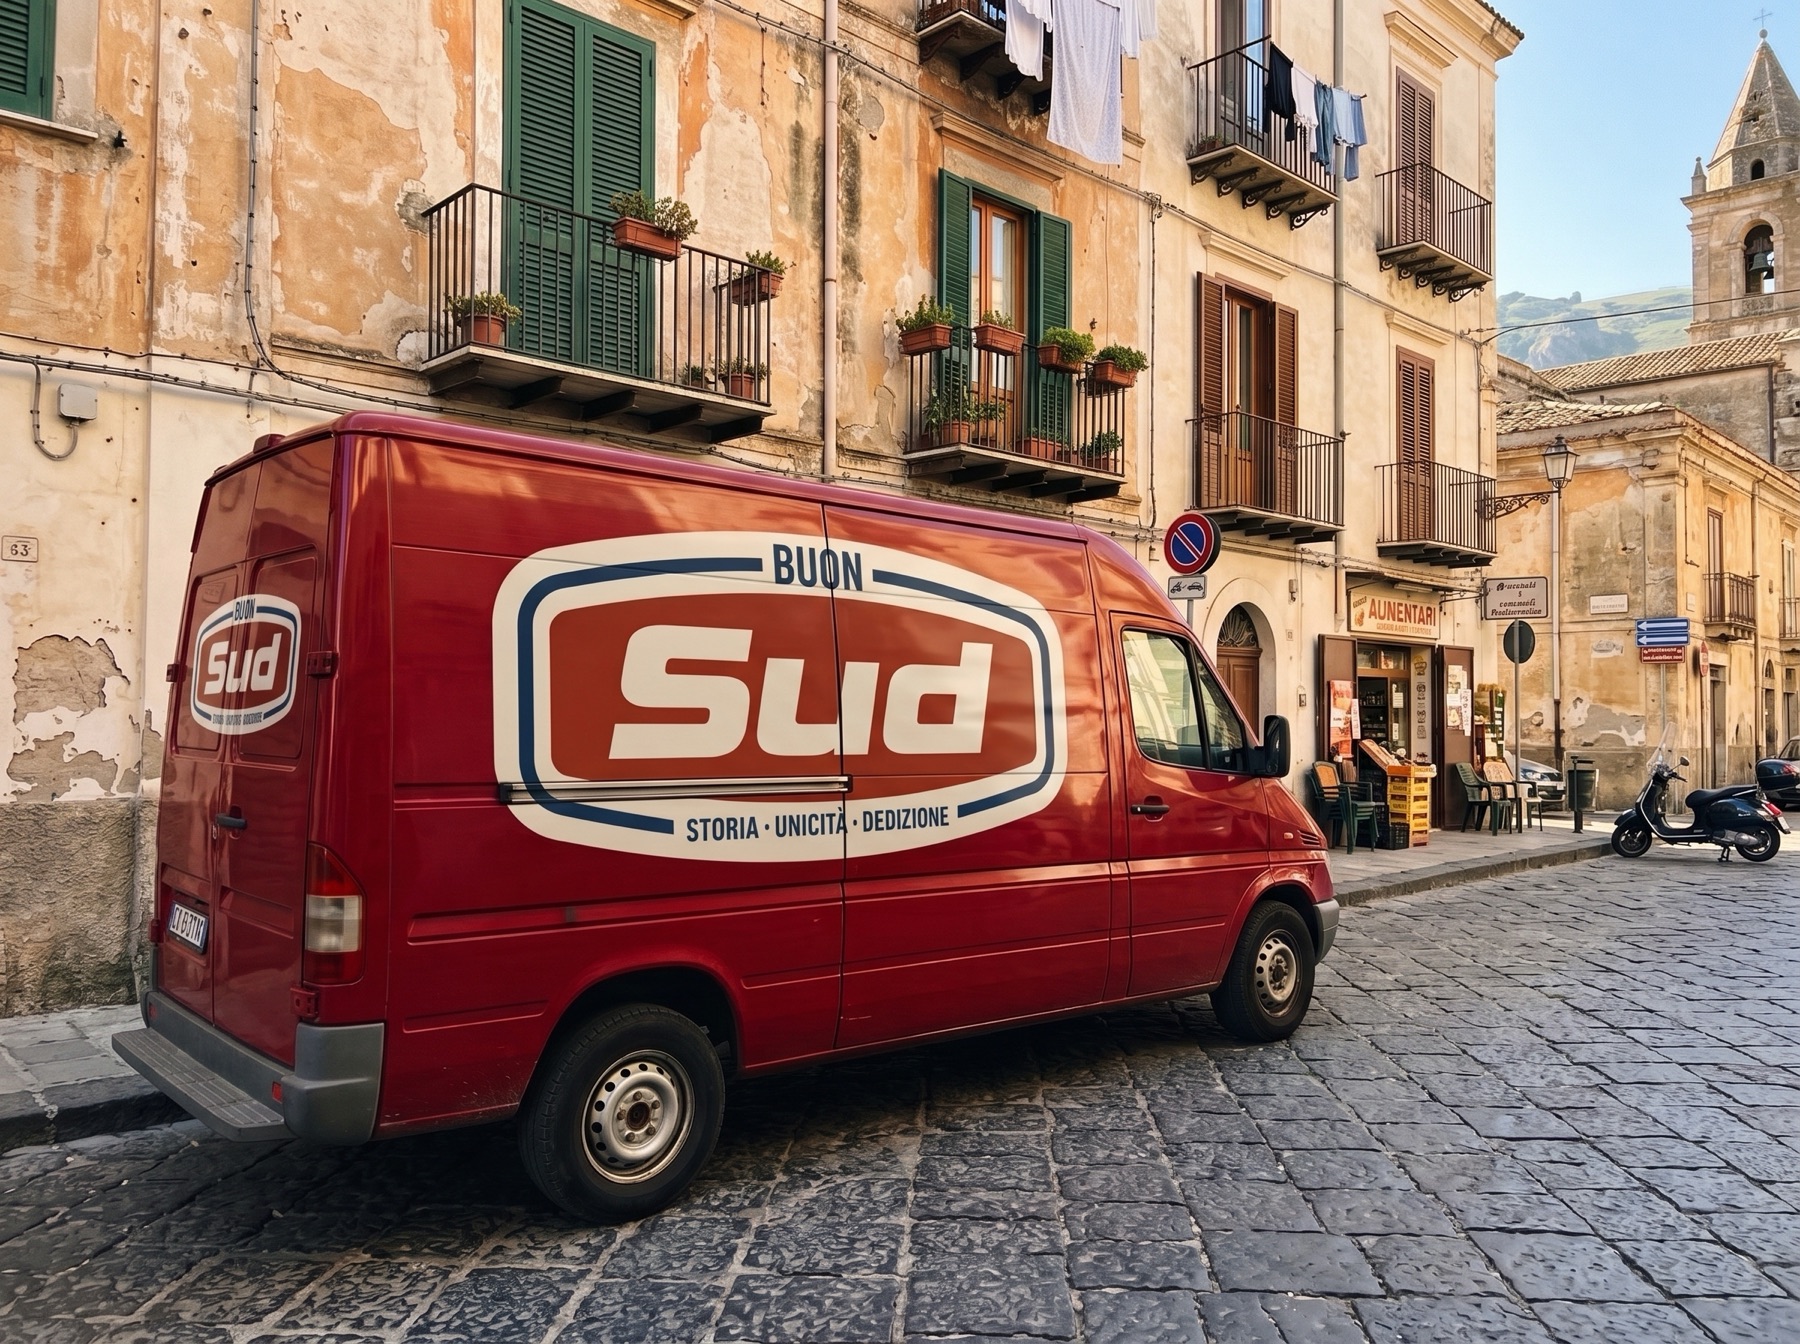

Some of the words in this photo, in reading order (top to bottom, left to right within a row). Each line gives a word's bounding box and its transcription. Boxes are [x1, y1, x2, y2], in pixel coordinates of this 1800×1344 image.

[10, 543, 29, 557] 63
[773, 543, 863, 591] BUON
[234, 598, 256, 621] BUON
[203, 632, 282, 695] Sud
[608, 624, 993, 760] Sud
[686, 816, 760, 842] STORIA
[774, 806, 848, 838] UNICITÀ
[862, 806, 950, 832] DEDIZIONE
